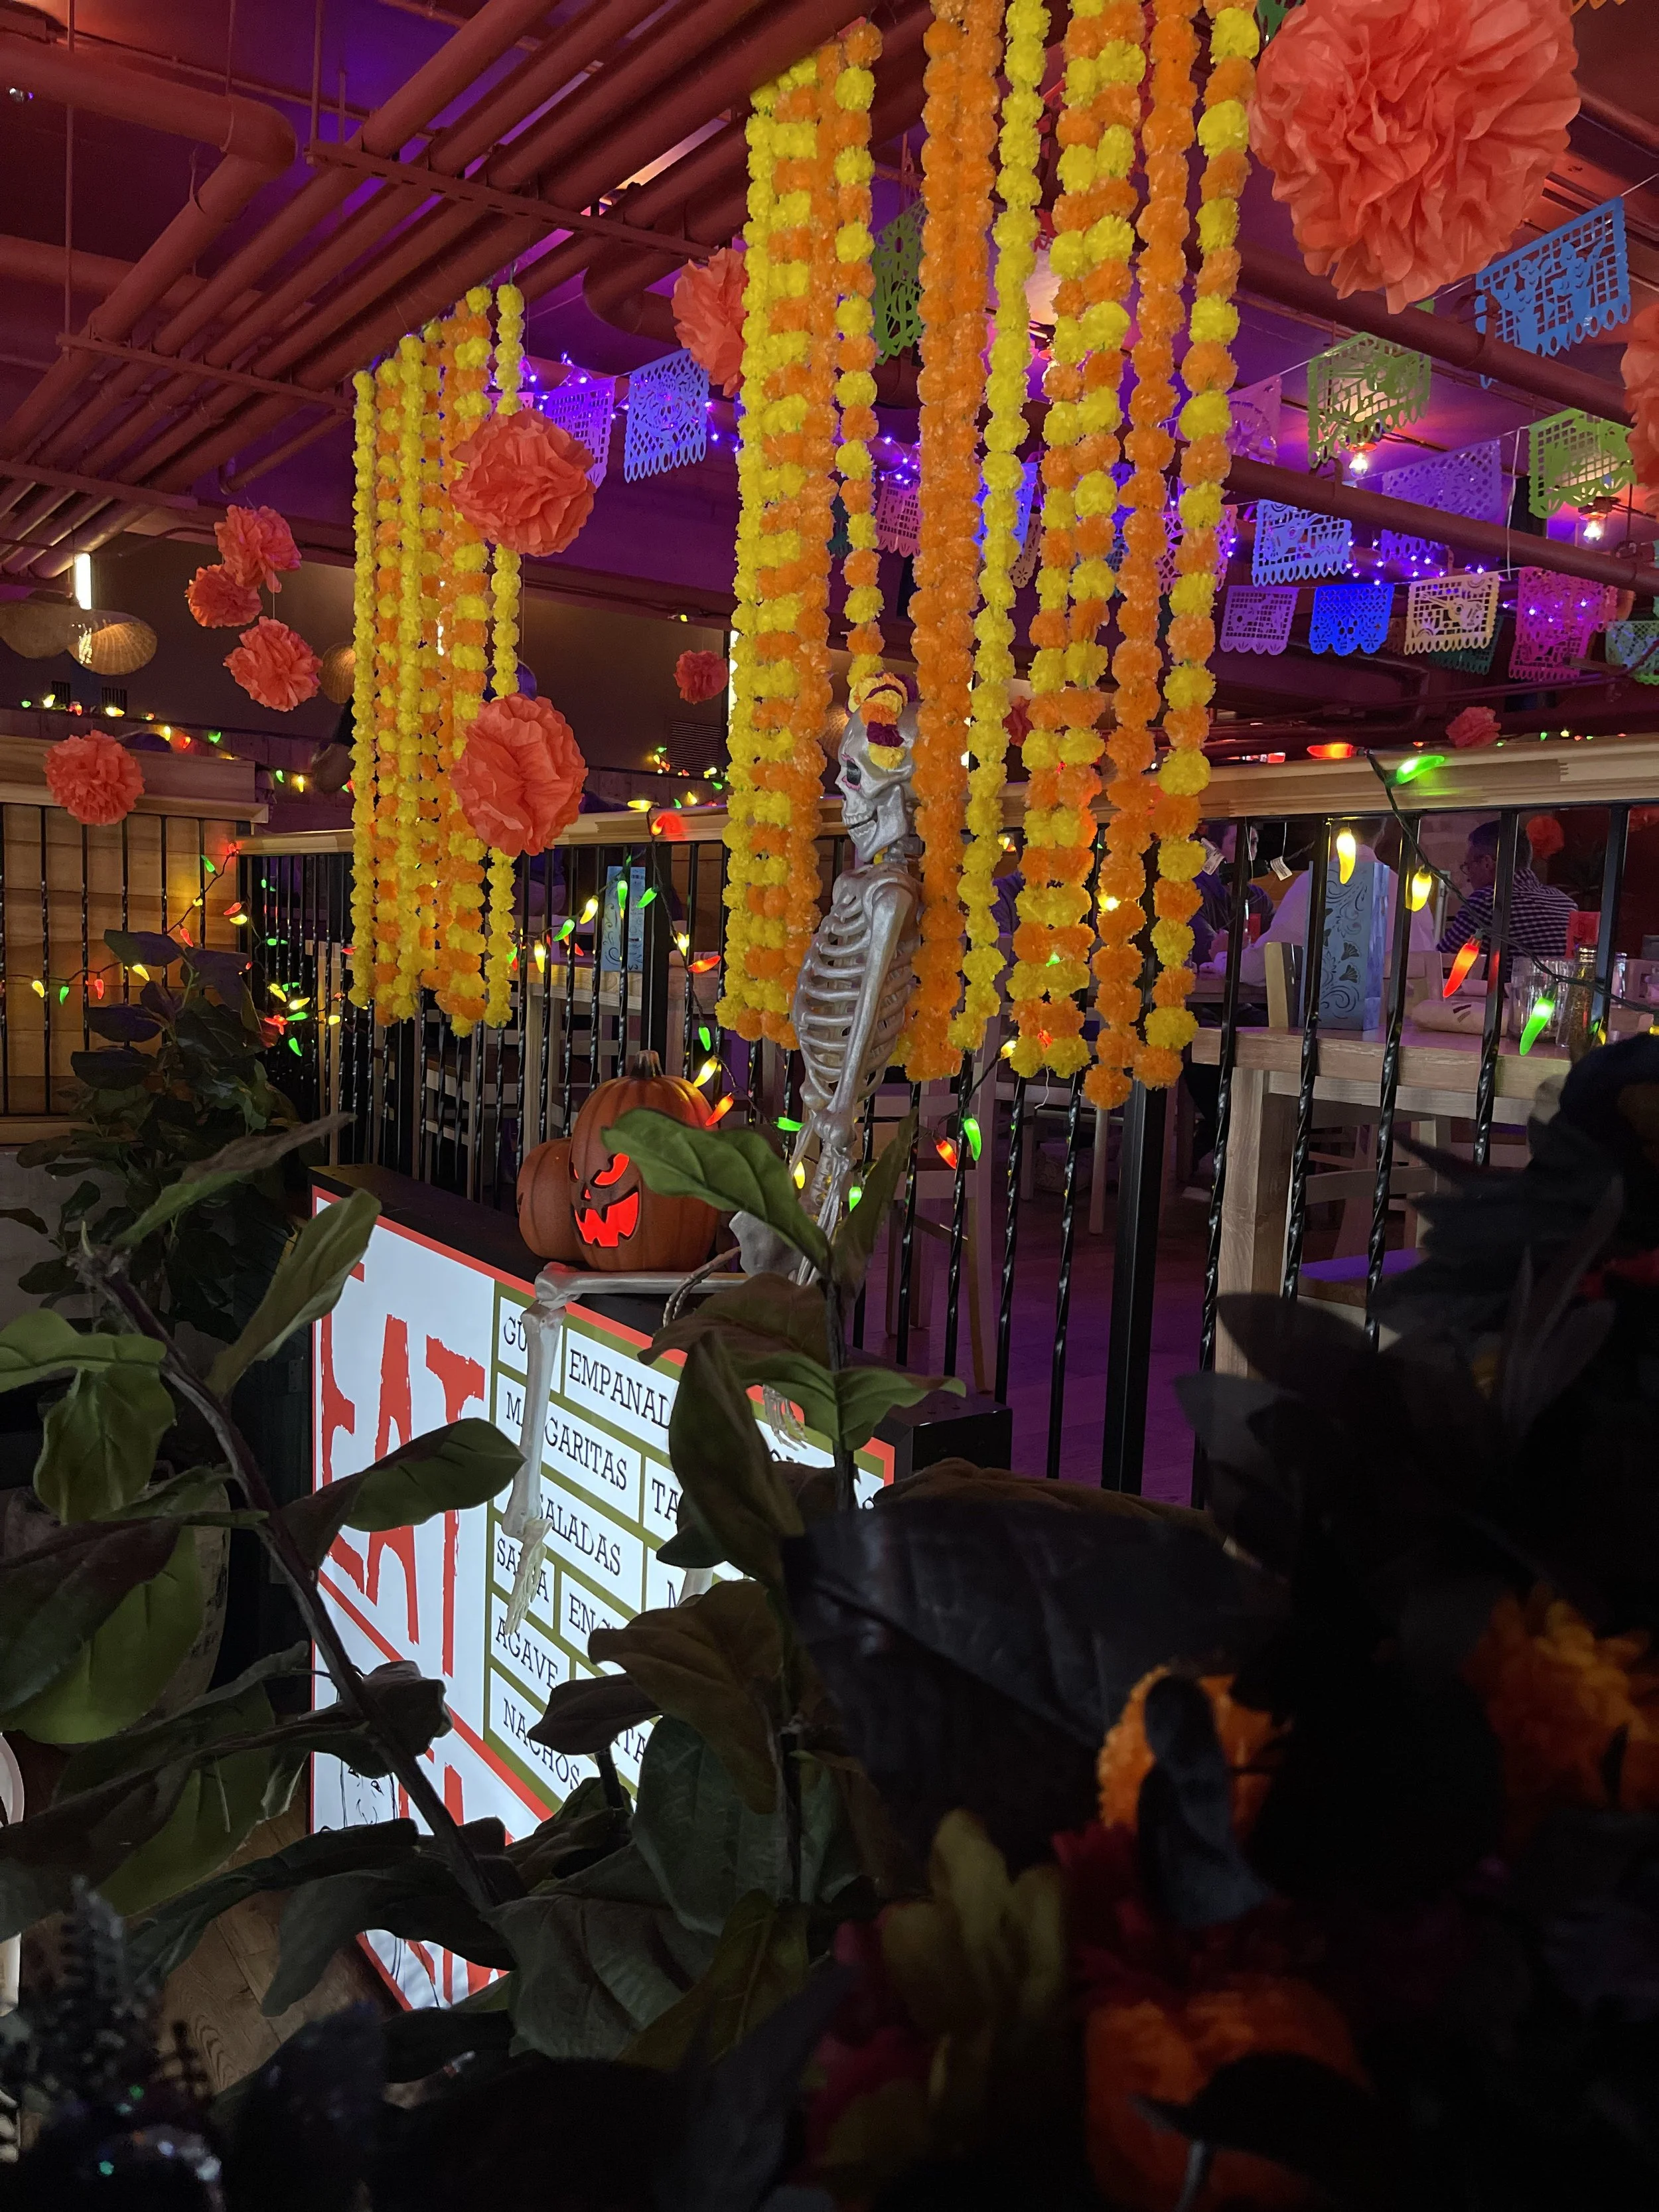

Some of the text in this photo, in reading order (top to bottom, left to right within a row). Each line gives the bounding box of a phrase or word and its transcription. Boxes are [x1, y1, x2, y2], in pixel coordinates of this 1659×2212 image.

[569, 1348, 670, 1430] EMPANAD
[321, 1260, 486, 1679] EAT
[506, 1391, 627, 1491] MGARITAS
[496, 1537, 550, 1603] SAA
[495, 1615, 558, 1690] AGAVE
